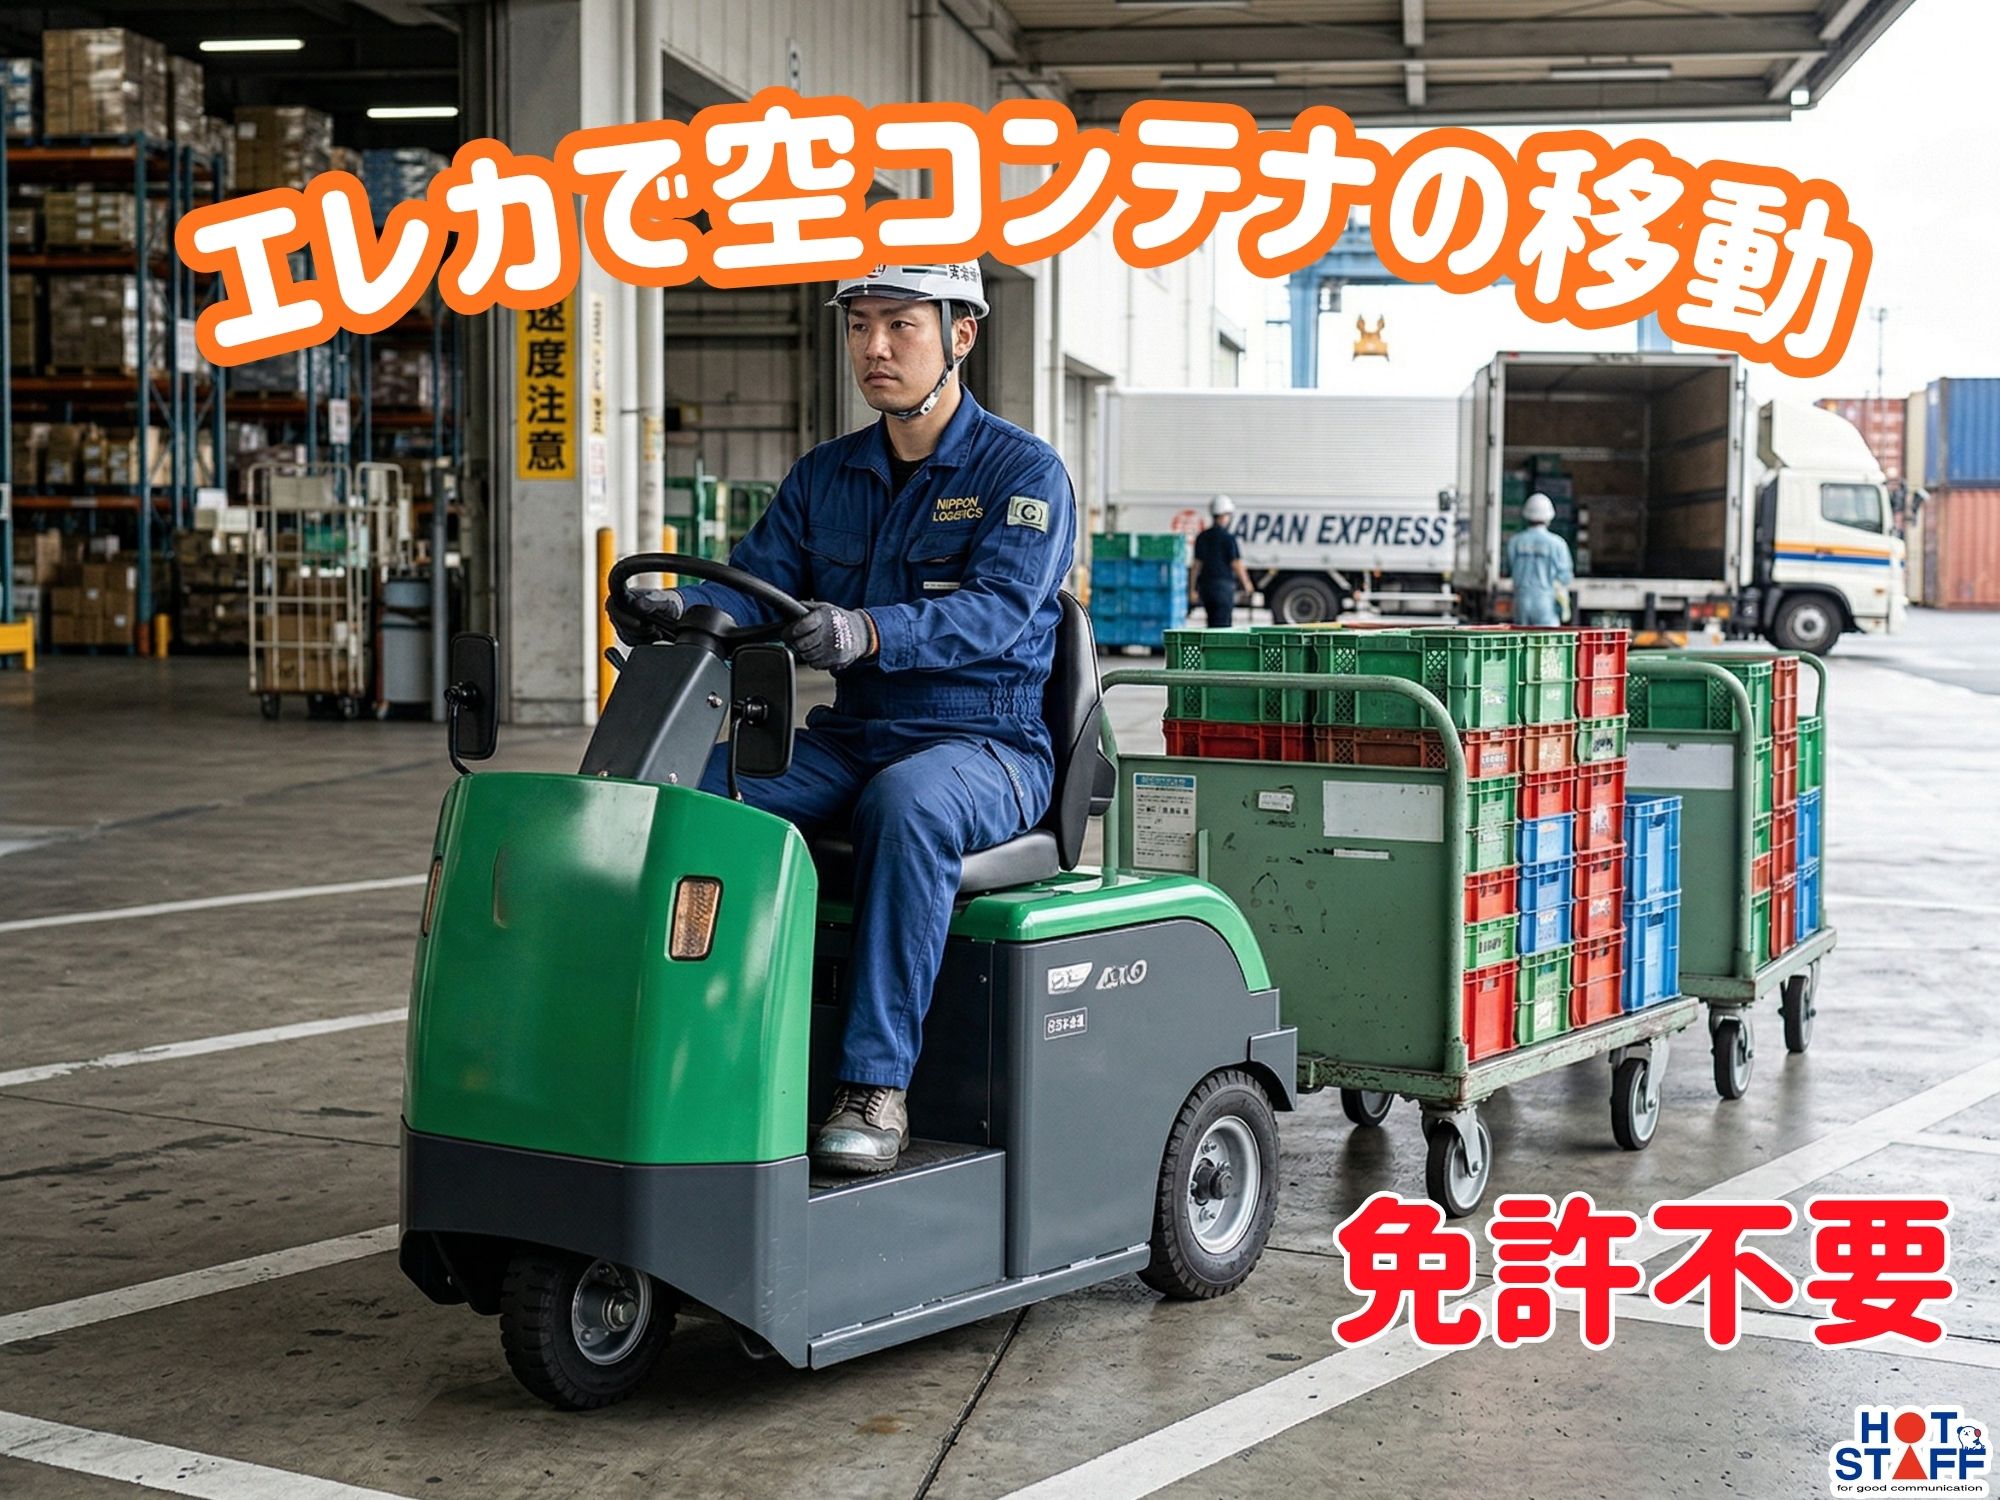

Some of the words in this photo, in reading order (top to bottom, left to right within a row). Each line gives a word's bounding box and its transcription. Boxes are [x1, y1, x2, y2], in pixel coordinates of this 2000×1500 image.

[526, 300, 566, 471] 速度注意
[936, 495, 979, 510] NIPPON
[1231, 513, 1309, 543] APAN
[1316, 515, 1448, 545] EXPRESS
